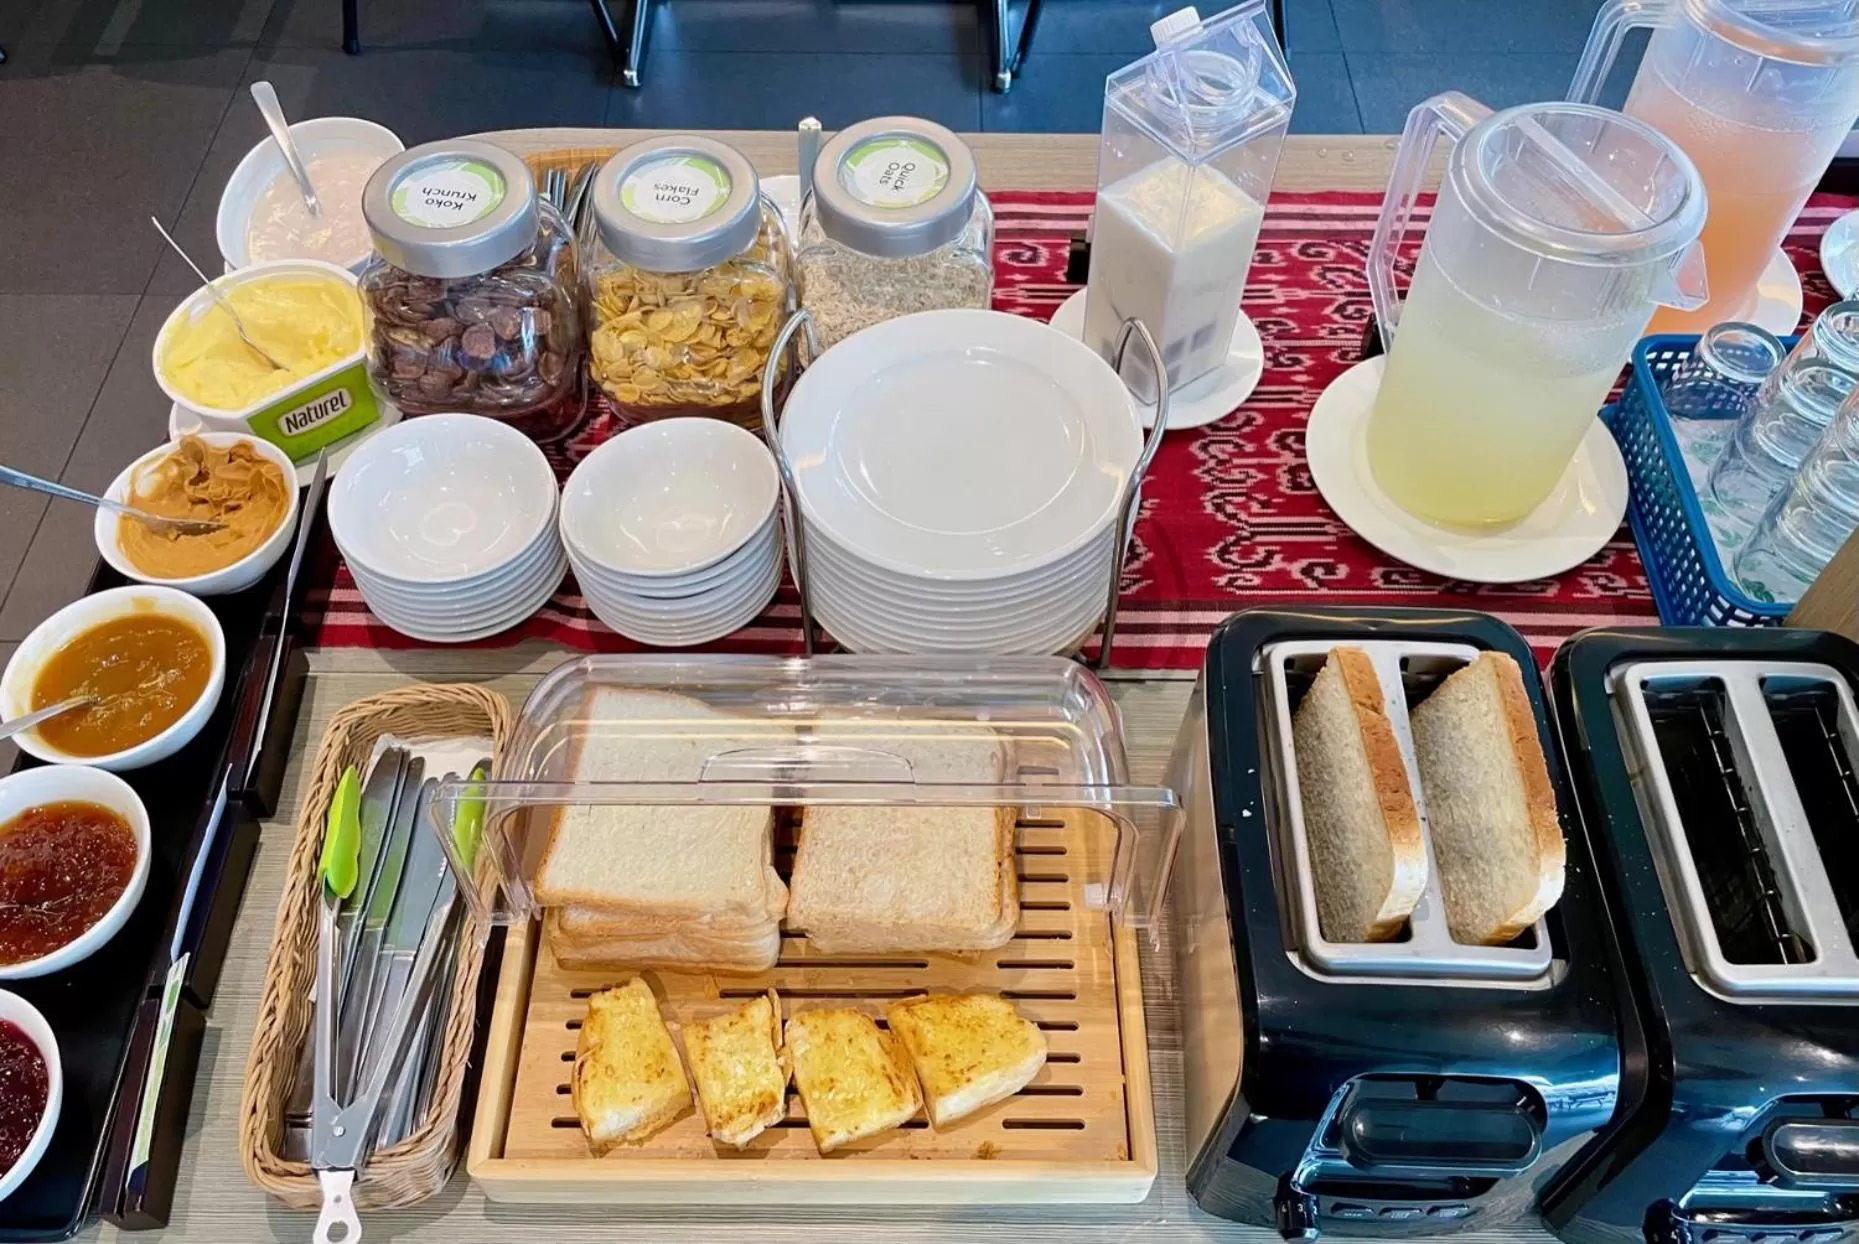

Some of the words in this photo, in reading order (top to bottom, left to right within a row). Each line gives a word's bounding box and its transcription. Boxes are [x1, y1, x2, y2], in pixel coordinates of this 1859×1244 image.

[879, 161, 901, 185] Oats
[892, 162, 917, 191] Quick
[421, 186, 478, 202] Krunch
[653, 183, 700, 196] Flakes
[424, 198, 464, 211] Koko
[655, 193, 691, 206] Corn
[284, 391, 347, 433] Naturel
